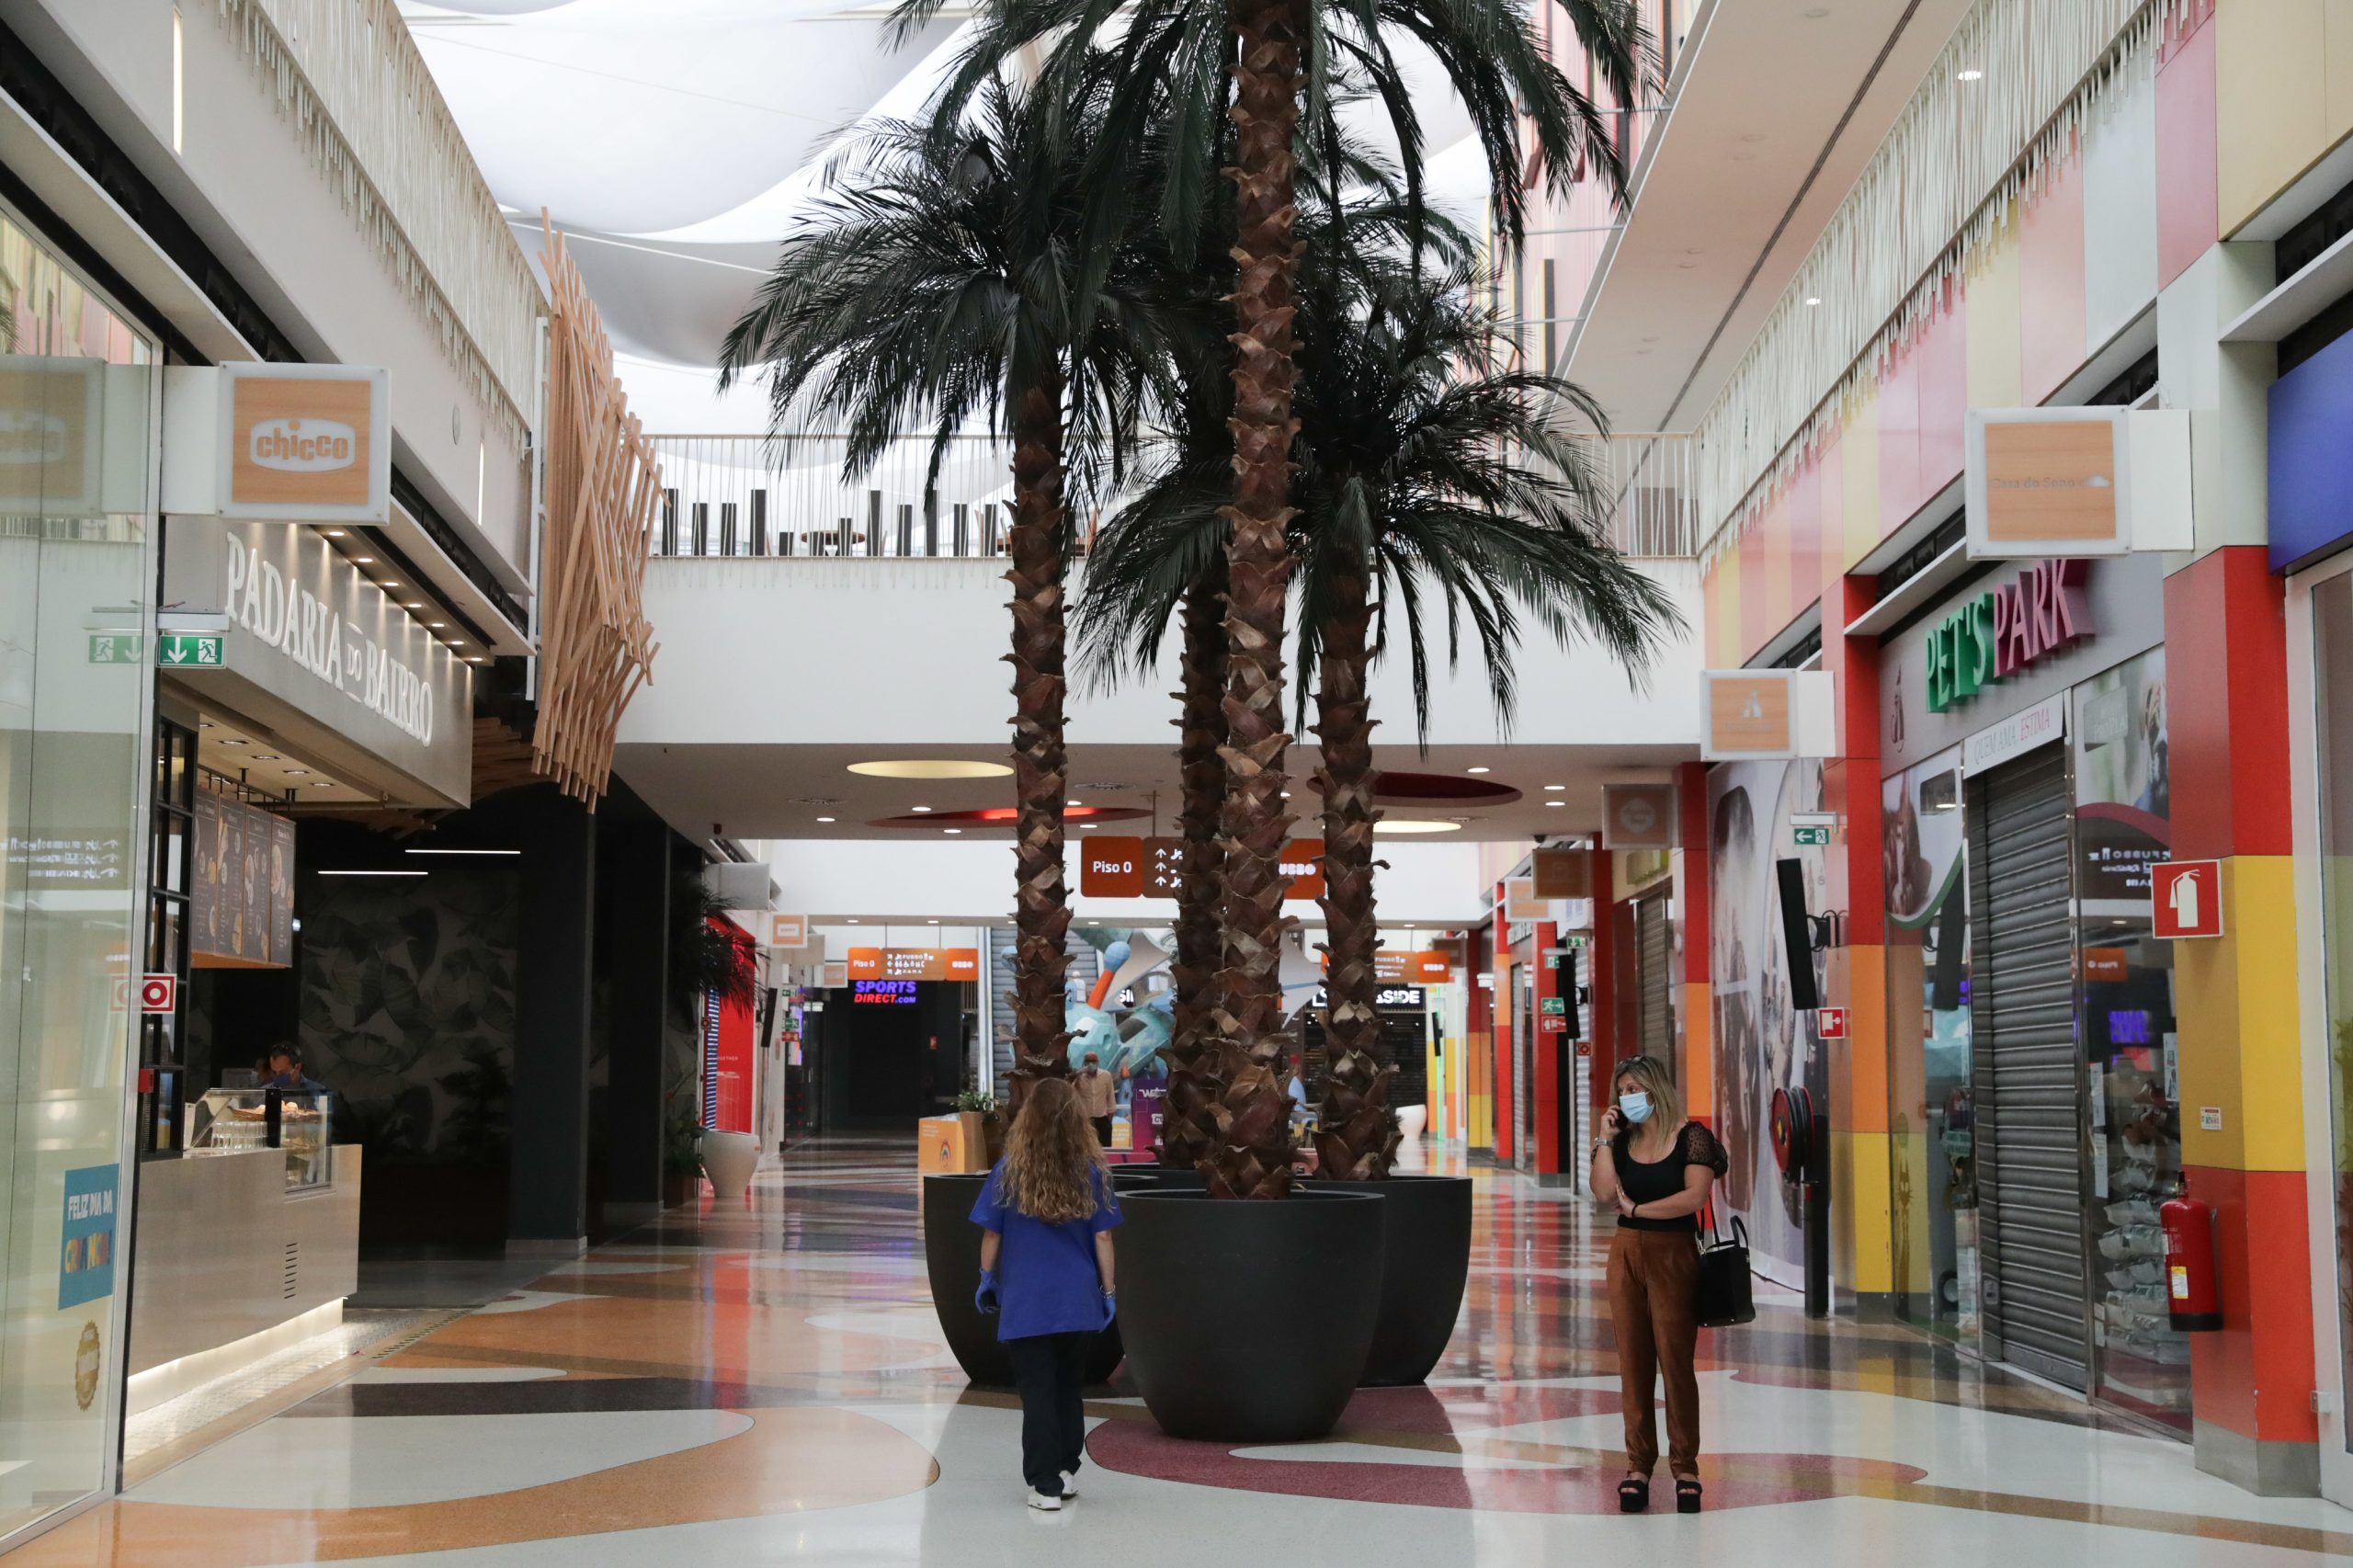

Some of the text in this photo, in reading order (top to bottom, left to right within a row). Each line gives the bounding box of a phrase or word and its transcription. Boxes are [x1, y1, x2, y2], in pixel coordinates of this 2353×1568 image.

[256, 420, 348, 460] chicco
[2024, 477, 2040, 488] do
[224, 531, 434, 747] PADARIA DO BAIRRO
[1926, 558, 2075, 713] PET'S PARK
[1974, 732, 1996, 765] QUEM
[2019, 706, 2051, 741] ESTIMA
[1092, 860, 1132, 873] Piso 0
[853, 960, 868, 968] Piso
[855, 980, 917, 994] SPORTS
[67, 1189, 113, 1221] FELIZ DIA DA
